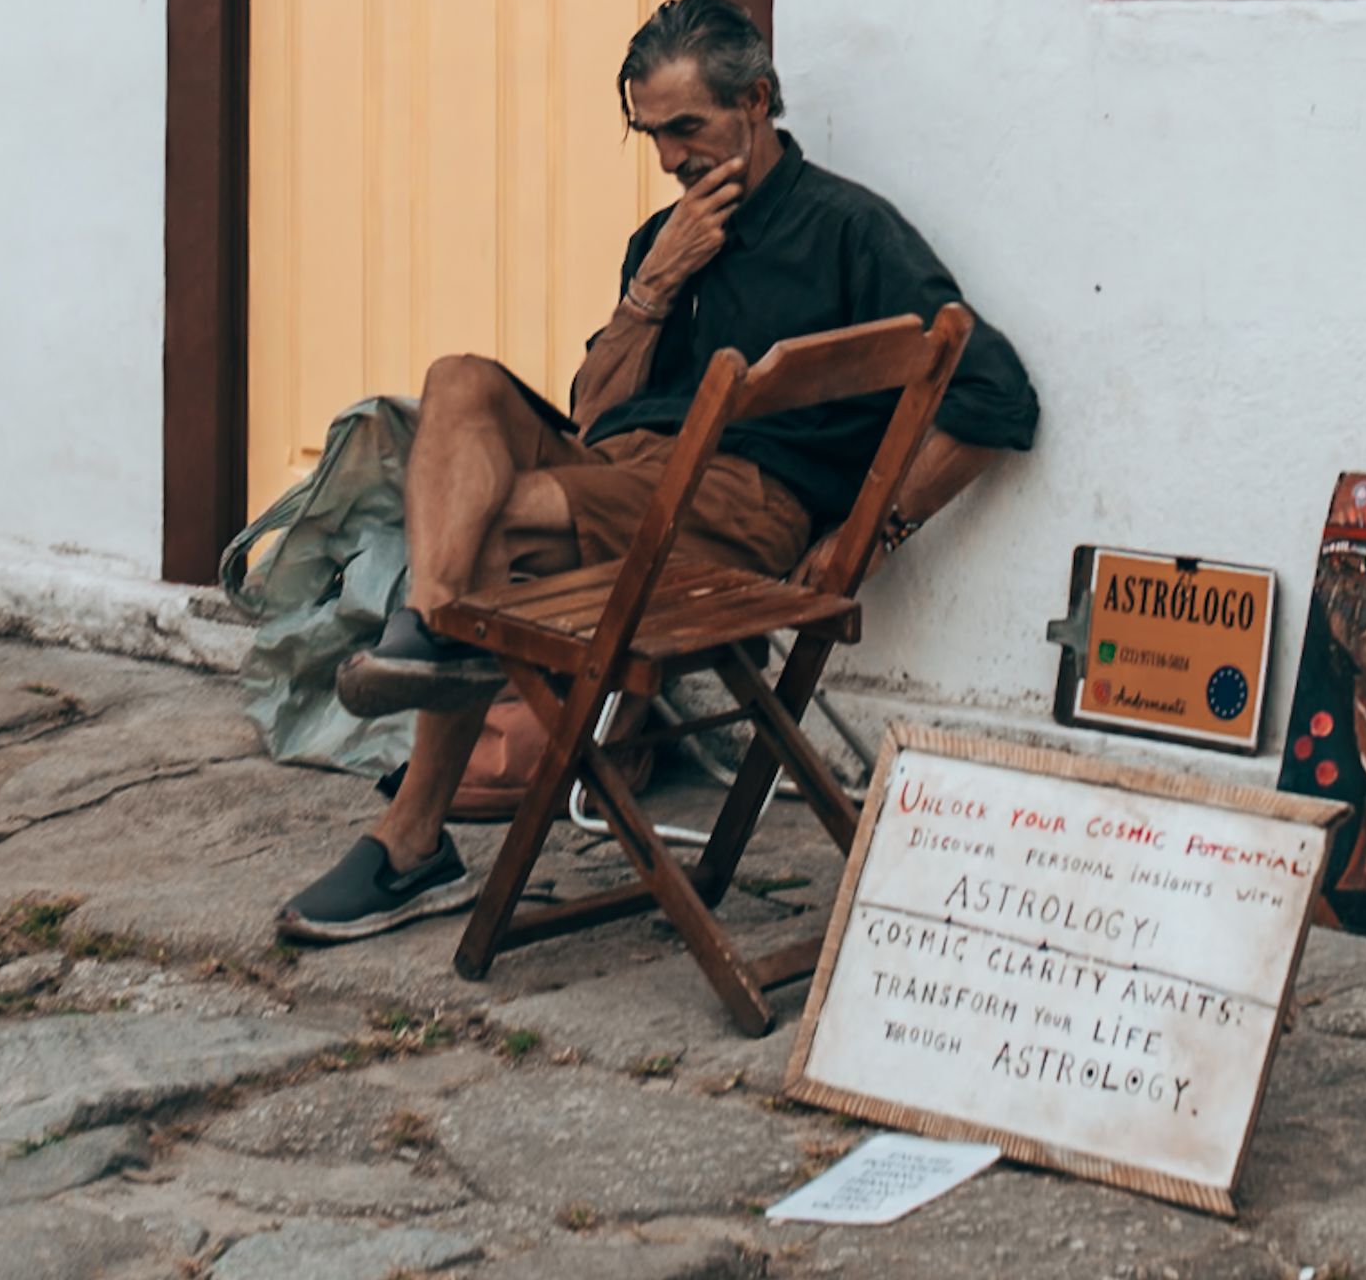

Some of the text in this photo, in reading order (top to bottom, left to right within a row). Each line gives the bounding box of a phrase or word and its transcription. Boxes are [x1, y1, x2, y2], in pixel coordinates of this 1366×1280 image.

[1104, 573, 1255, 630] ASTRÓLOGO
[1011, 808, 1066, 833] YOUR
[1086, 817, 1166, 850] COSMIC
[1026, 849, 1114, 879] PERSONAL
[945, 874, 1160, 948] ASTROLOGY!
[868, 919, 968, 962] COSMIC
[988, 948, 1107, 994] CLARITY
[872, 971, 1162, 1055] TRANSFORM YOUR LIFE
